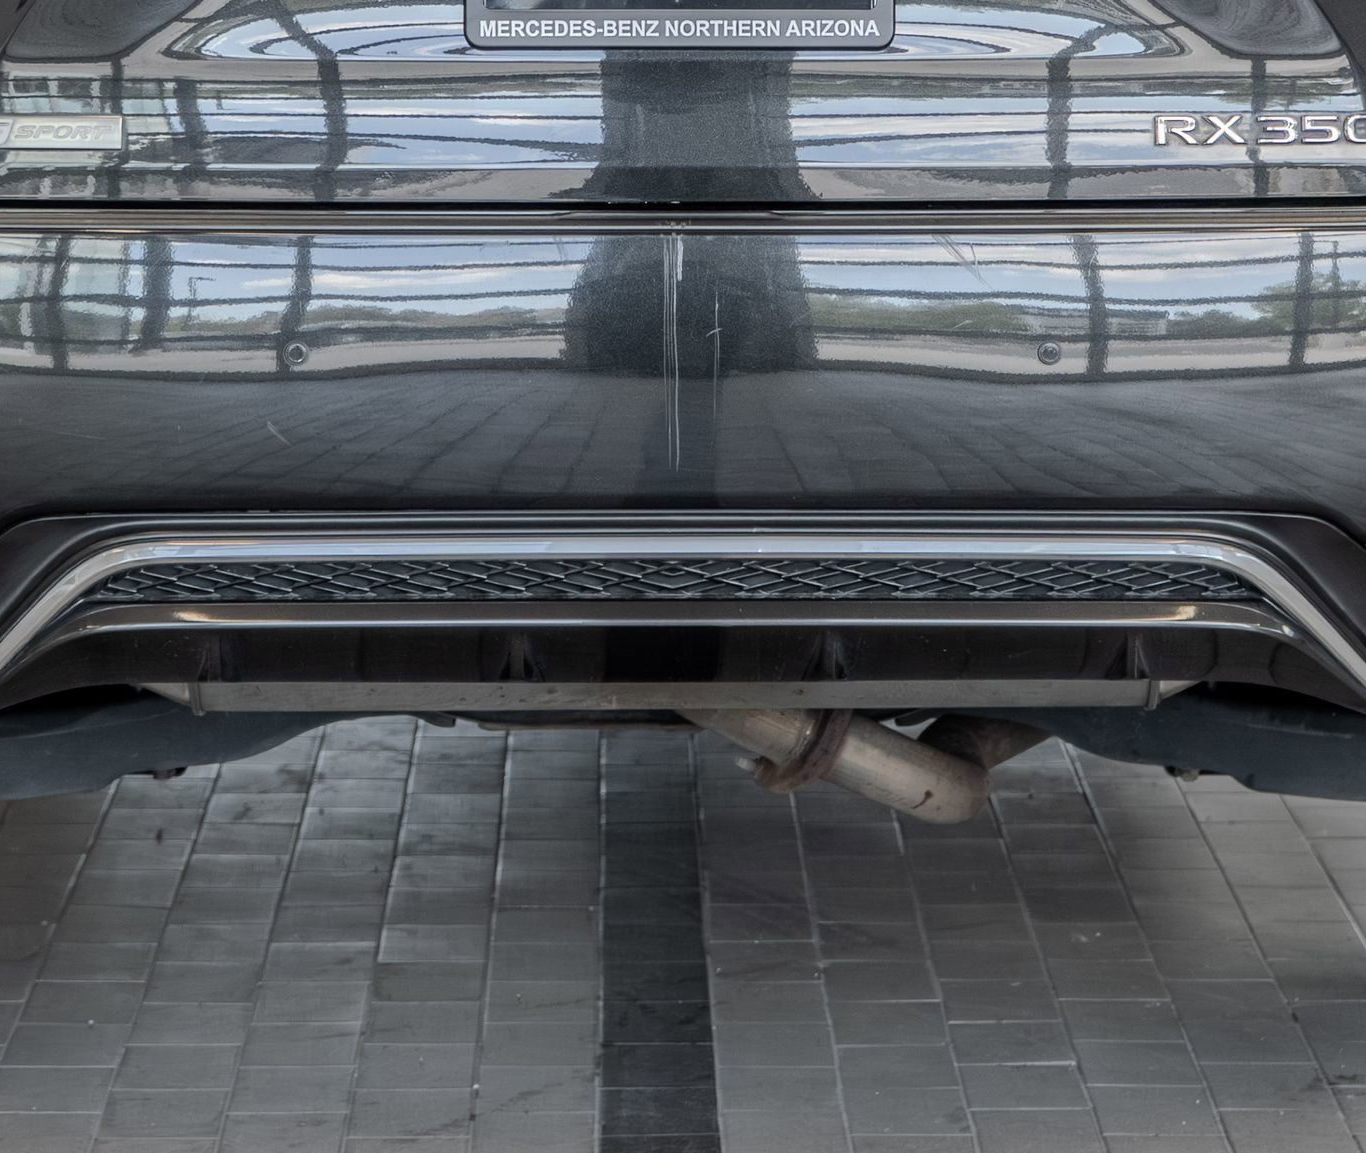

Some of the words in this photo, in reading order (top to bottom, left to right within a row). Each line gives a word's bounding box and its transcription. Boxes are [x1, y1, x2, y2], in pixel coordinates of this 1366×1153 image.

[479, 20, 660, 38] MERCEDES-BENZ
[665, 20, 780, 38] NORTHERN
[785, 20, 880, 38] ARIZONA
[14, 125, 110, 140] SPORT
